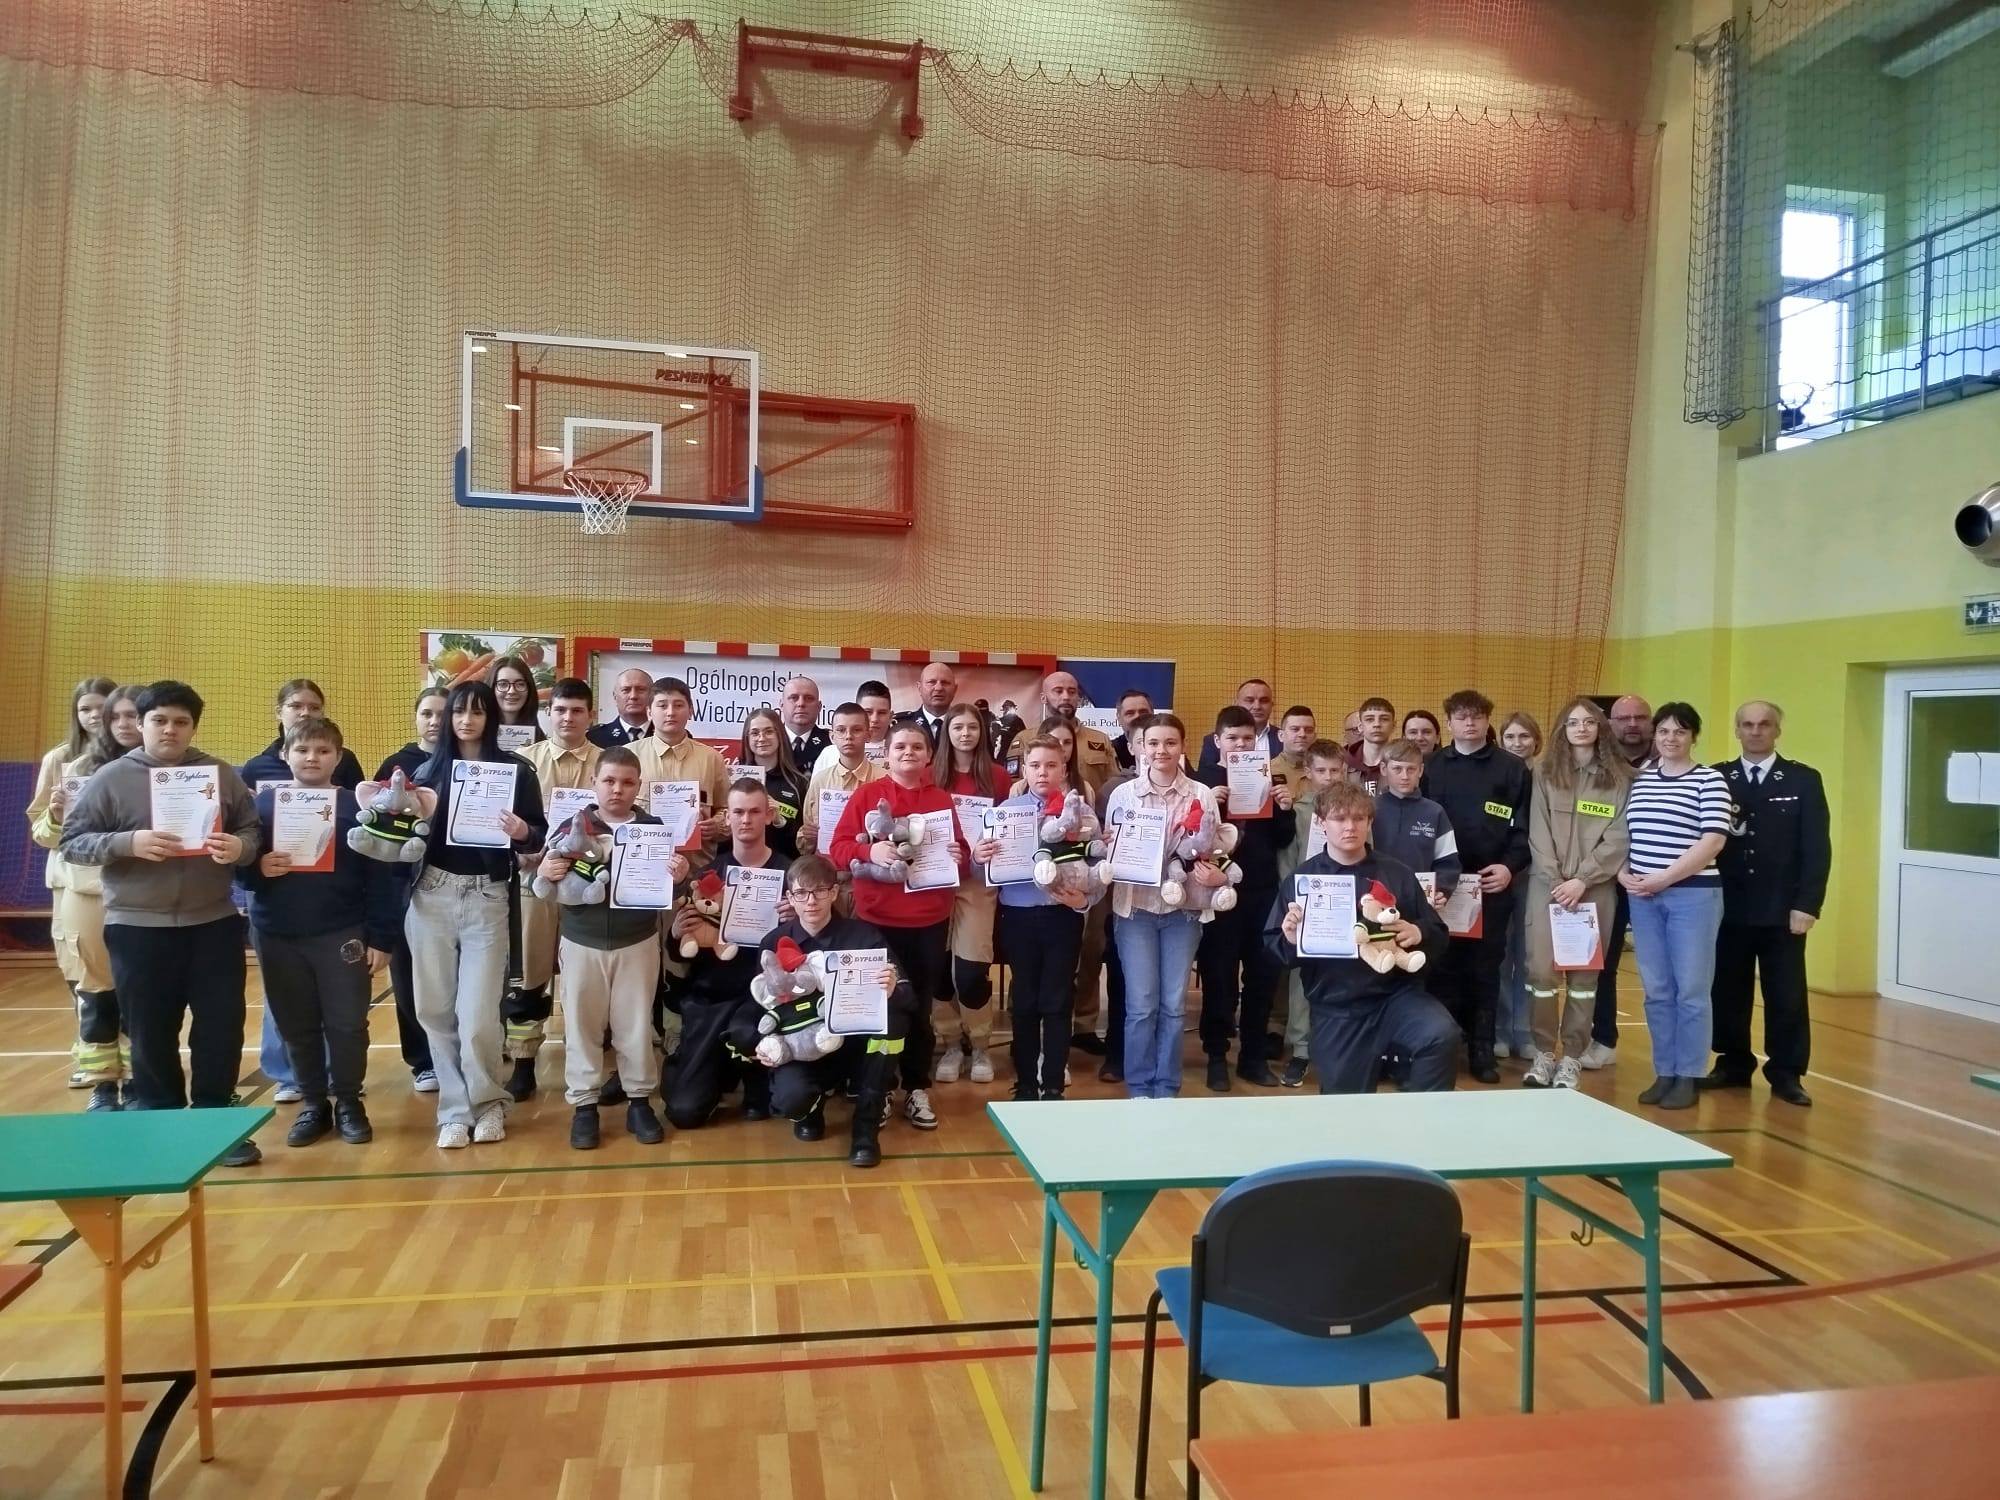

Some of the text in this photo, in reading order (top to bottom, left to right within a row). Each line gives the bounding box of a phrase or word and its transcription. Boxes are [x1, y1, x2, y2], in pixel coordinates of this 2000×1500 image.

[655, 368, 733, 386] PESMENPOL
[174, 770, 210, 782] Dyplom
[483, 768, 513, 777] DYPLOM
[296, 791, 329, 804] Dyplom
[753, 874, 781, 882] DYPLOM
